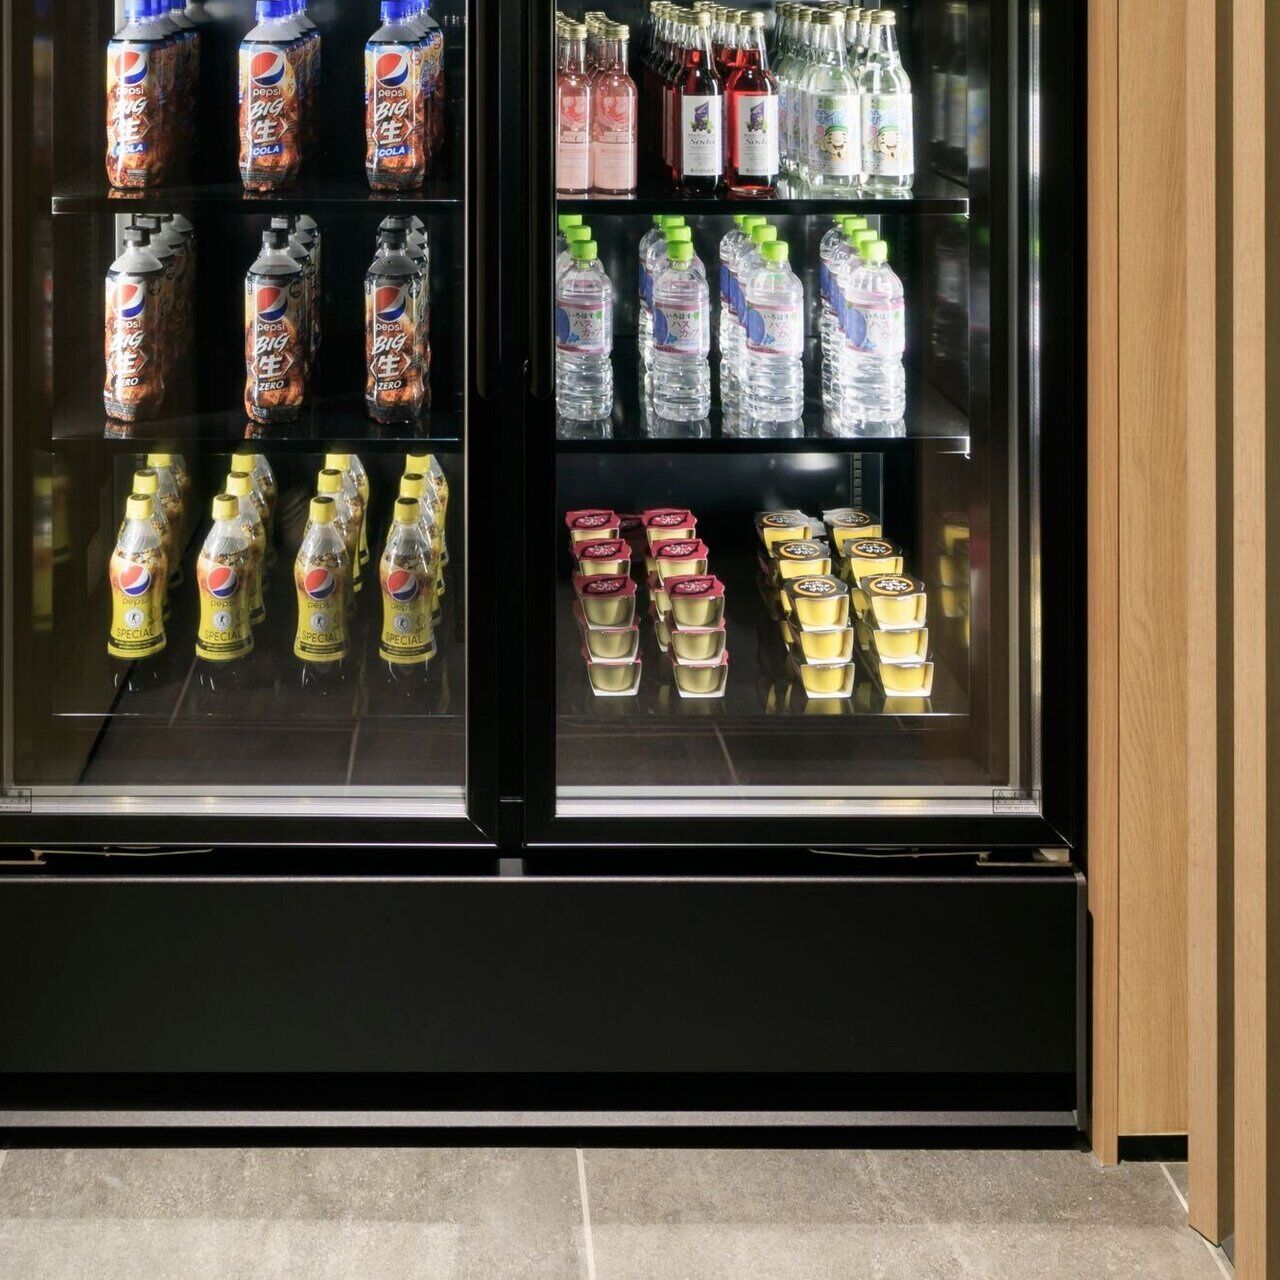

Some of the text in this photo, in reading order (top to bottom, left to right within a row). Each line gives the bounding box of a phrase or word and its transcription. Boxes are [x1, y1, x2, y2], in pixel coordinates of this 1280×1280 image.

[252, 88, 281, 98] pepsi
[378, 89, 406, 99] pepsi
[250, 98, 287, 120] BIG
[376, 98, 410, 120] BIG
[253, 145, 280, 156] COLA
[378, 146, 406, 157] COLA
[256, 323, 285, 332] pepsi
[375, 322, 403, 332] pepsi
[254, 332, 291, 355] BIG
[372, 332, 409, 355] BIG
[258, 380, 285, 391] ZERO
[377, 380, 402, 391] ZERO
[116, 627, 155, 640] SPECIAL
[204, 629, 241, 642] SPECIAL
[301, 631, 339, 644] SPECIAL
[385, 631, 423, 646] SPECIAL
